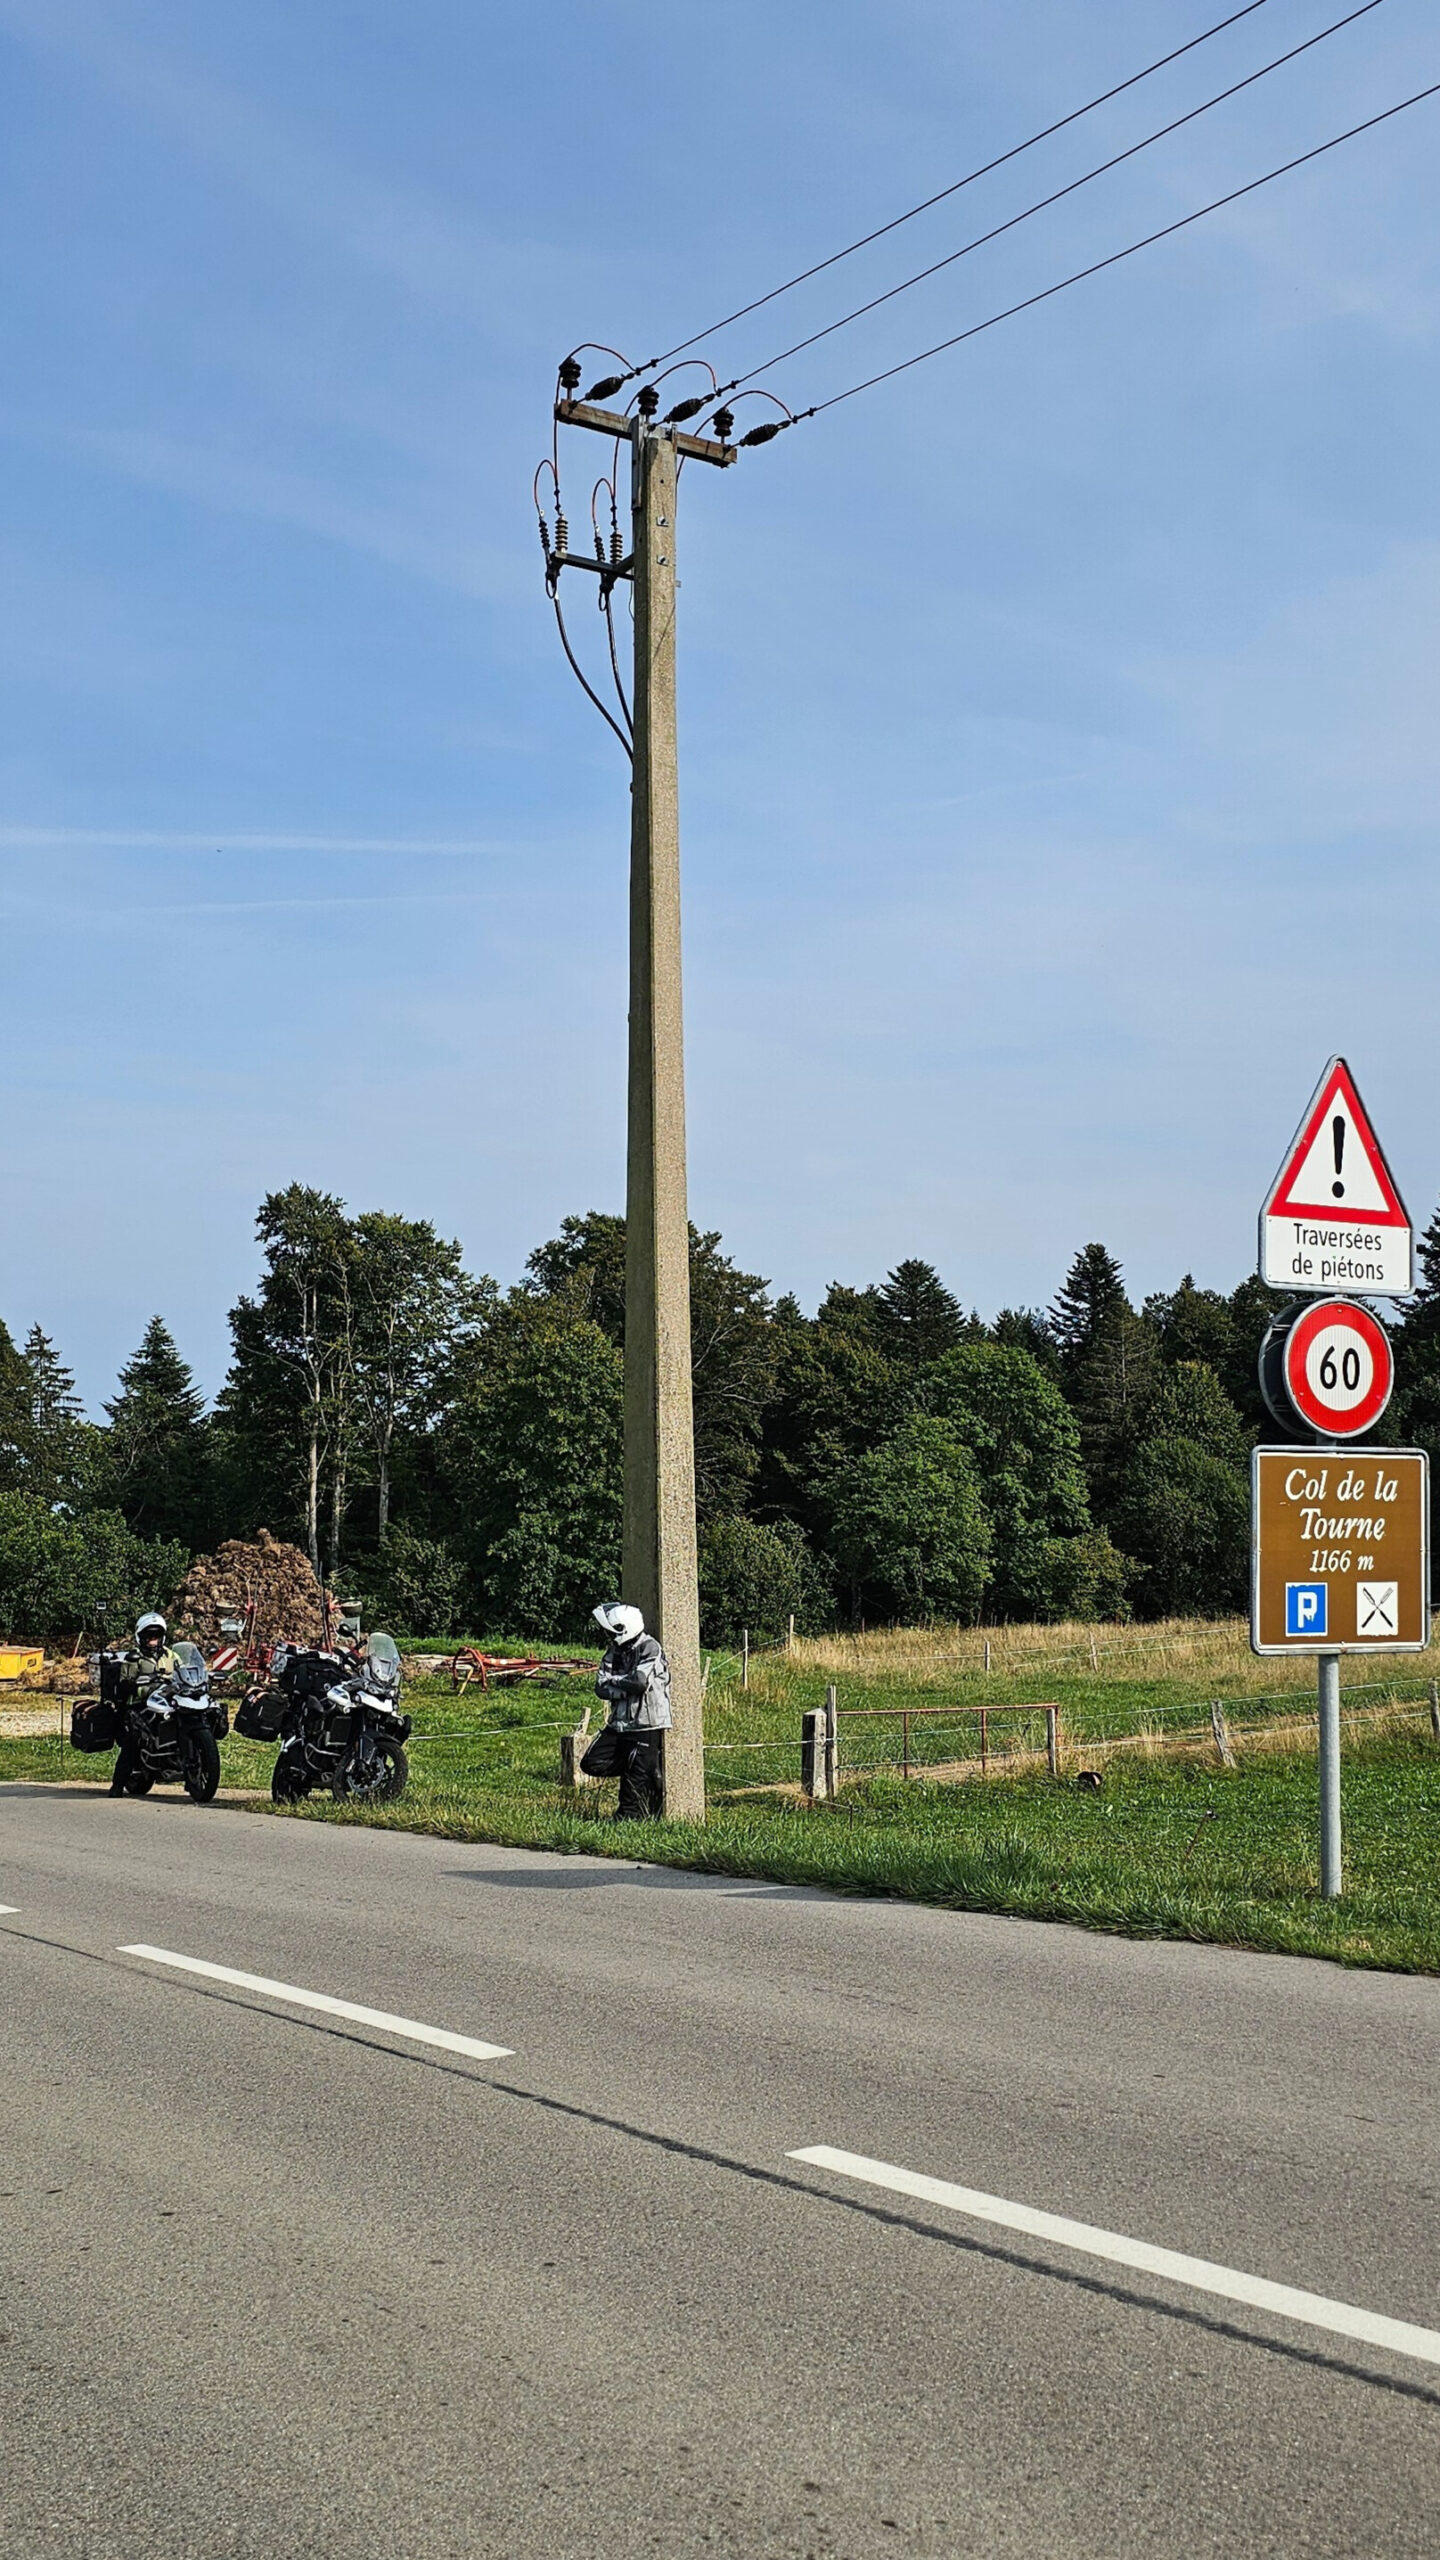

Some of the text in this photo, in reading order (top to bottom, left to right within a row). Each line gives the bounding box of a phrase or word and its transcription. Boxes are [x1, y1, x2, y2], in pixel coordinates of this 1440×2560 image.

[1294, 1223, 1382, 1251] Traversées
[1292, 1252, 1384, 1282] de piétons
[1320, 1346, 1360, 1390] 60
[1286, 1468, 1399, 1502] Col de la
[1299, 1508, 1385, 1541] Tourne
[1309, 1549, 1374, 1573] 1166 m
[1297, 1591, 1318, 1629] P
